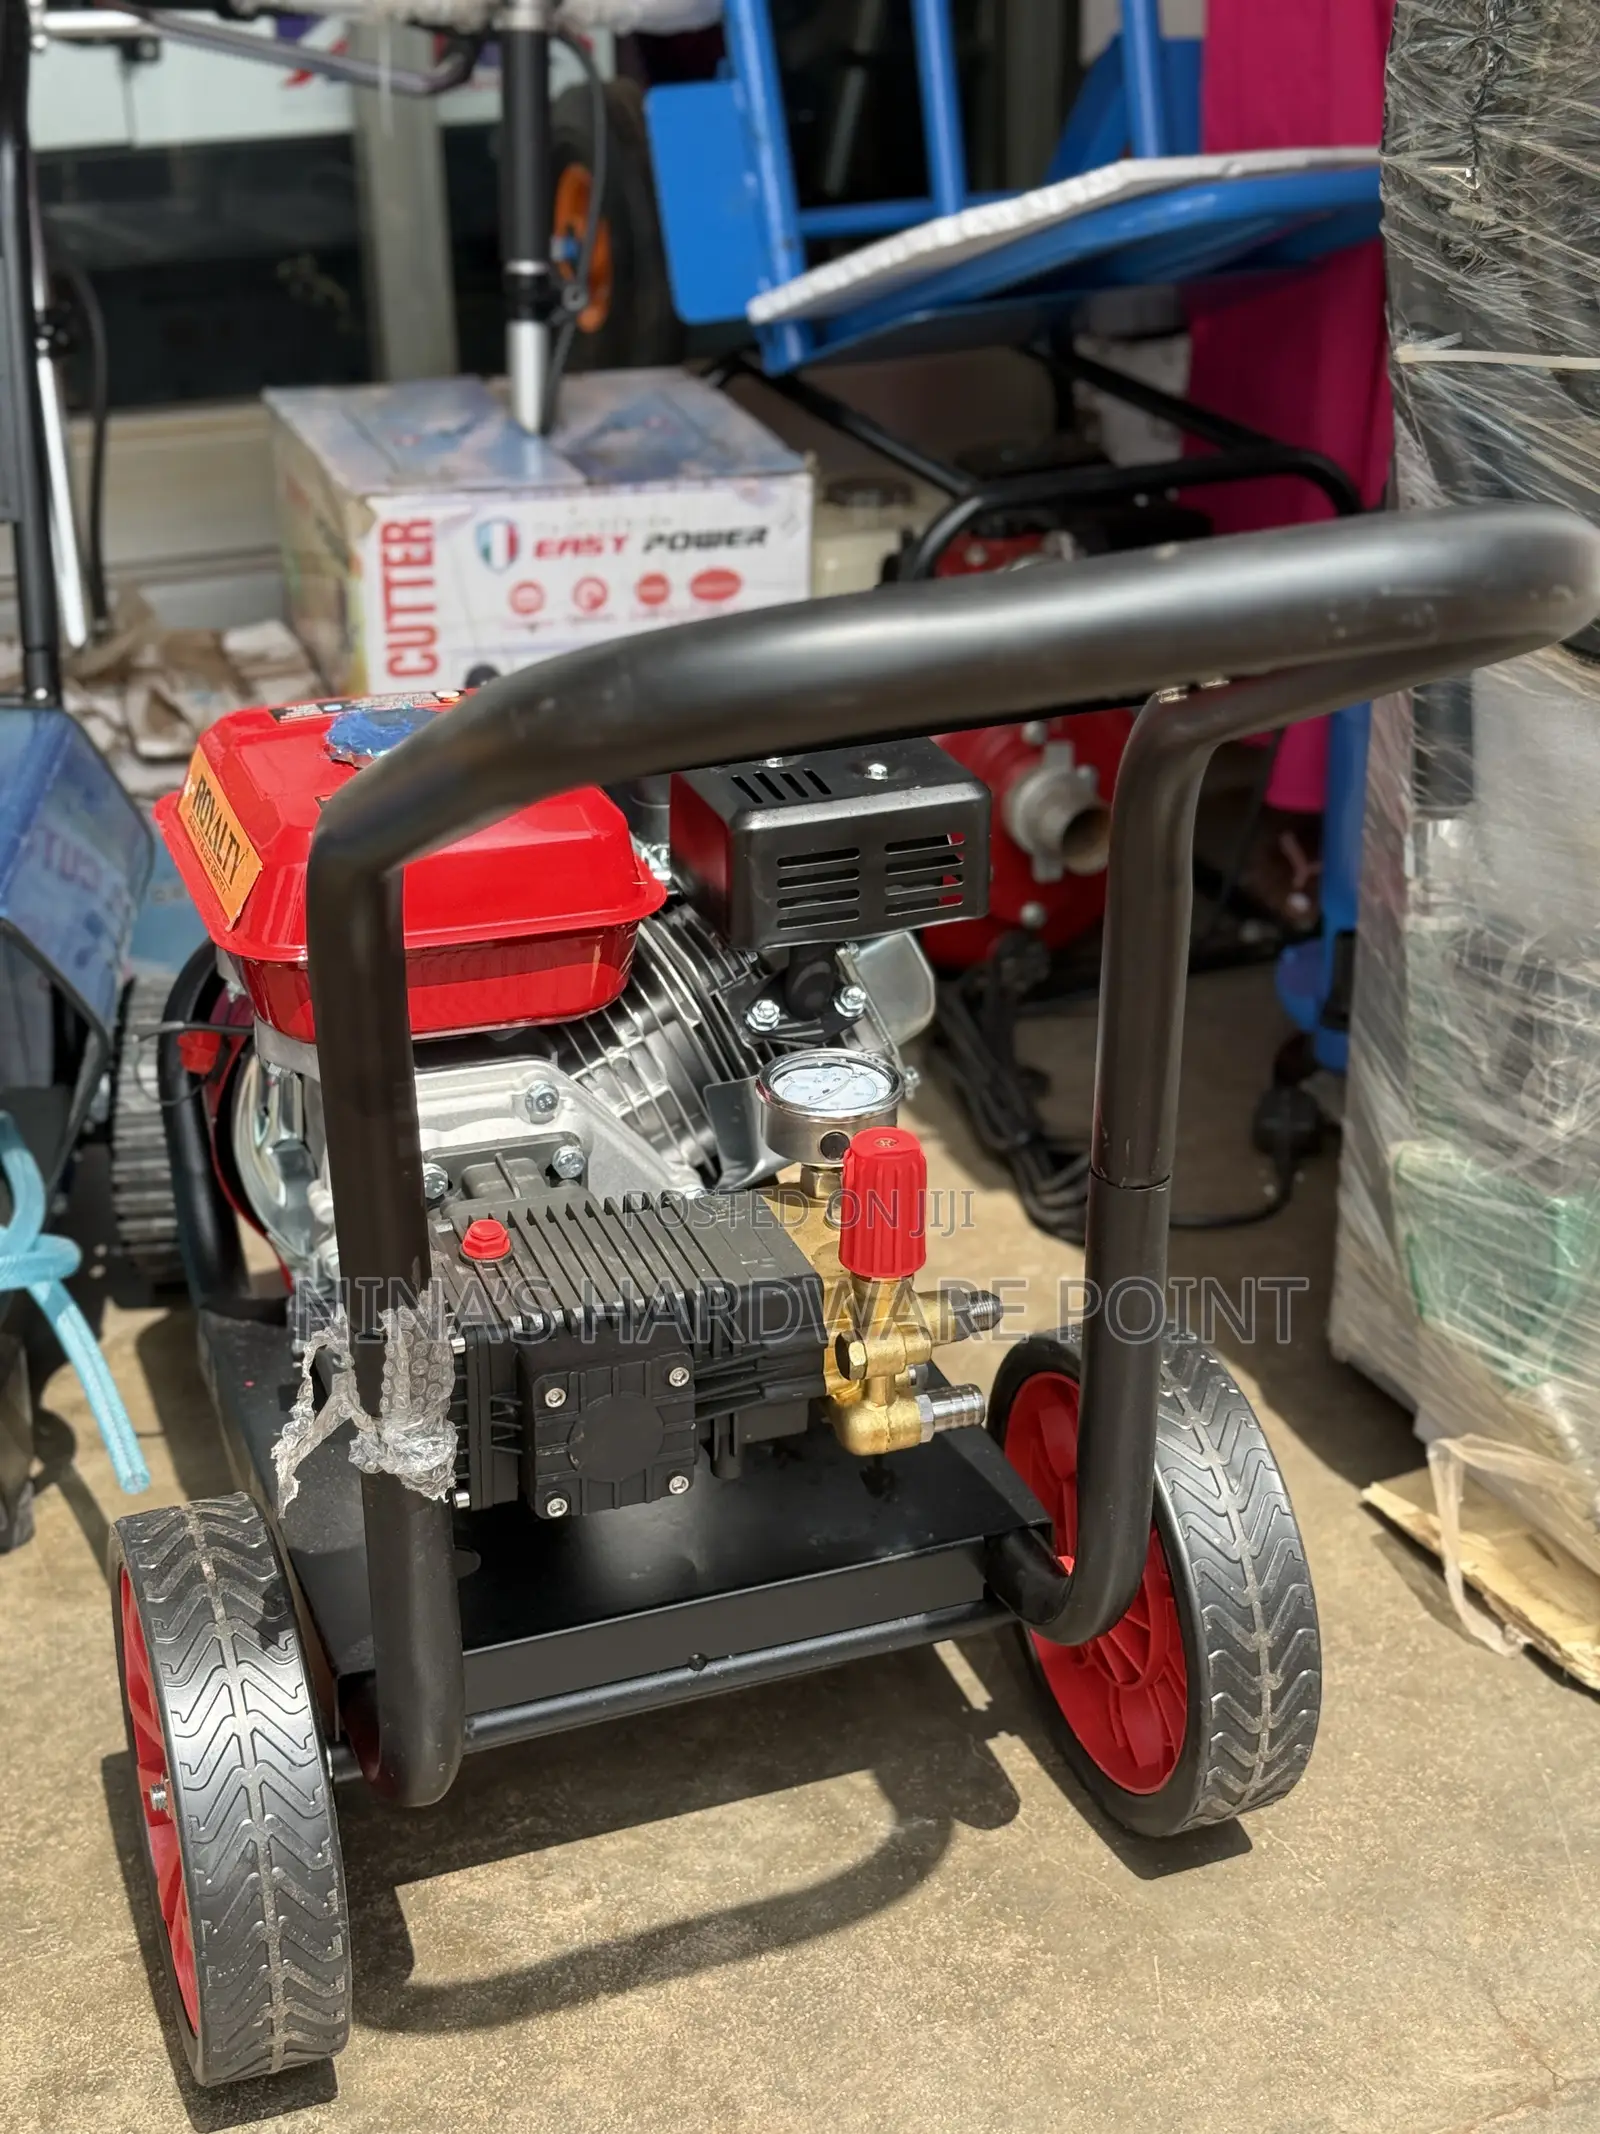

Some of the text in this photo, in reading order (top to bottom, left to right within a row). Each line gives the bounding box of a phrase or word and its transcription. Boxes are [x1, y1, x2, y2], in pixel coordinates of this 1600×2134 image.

[381, 518, 439, 678] CUTTER
[532, 525, 769, 560] EASY POWER
[192, 773, 246, 886] ROYALTY
